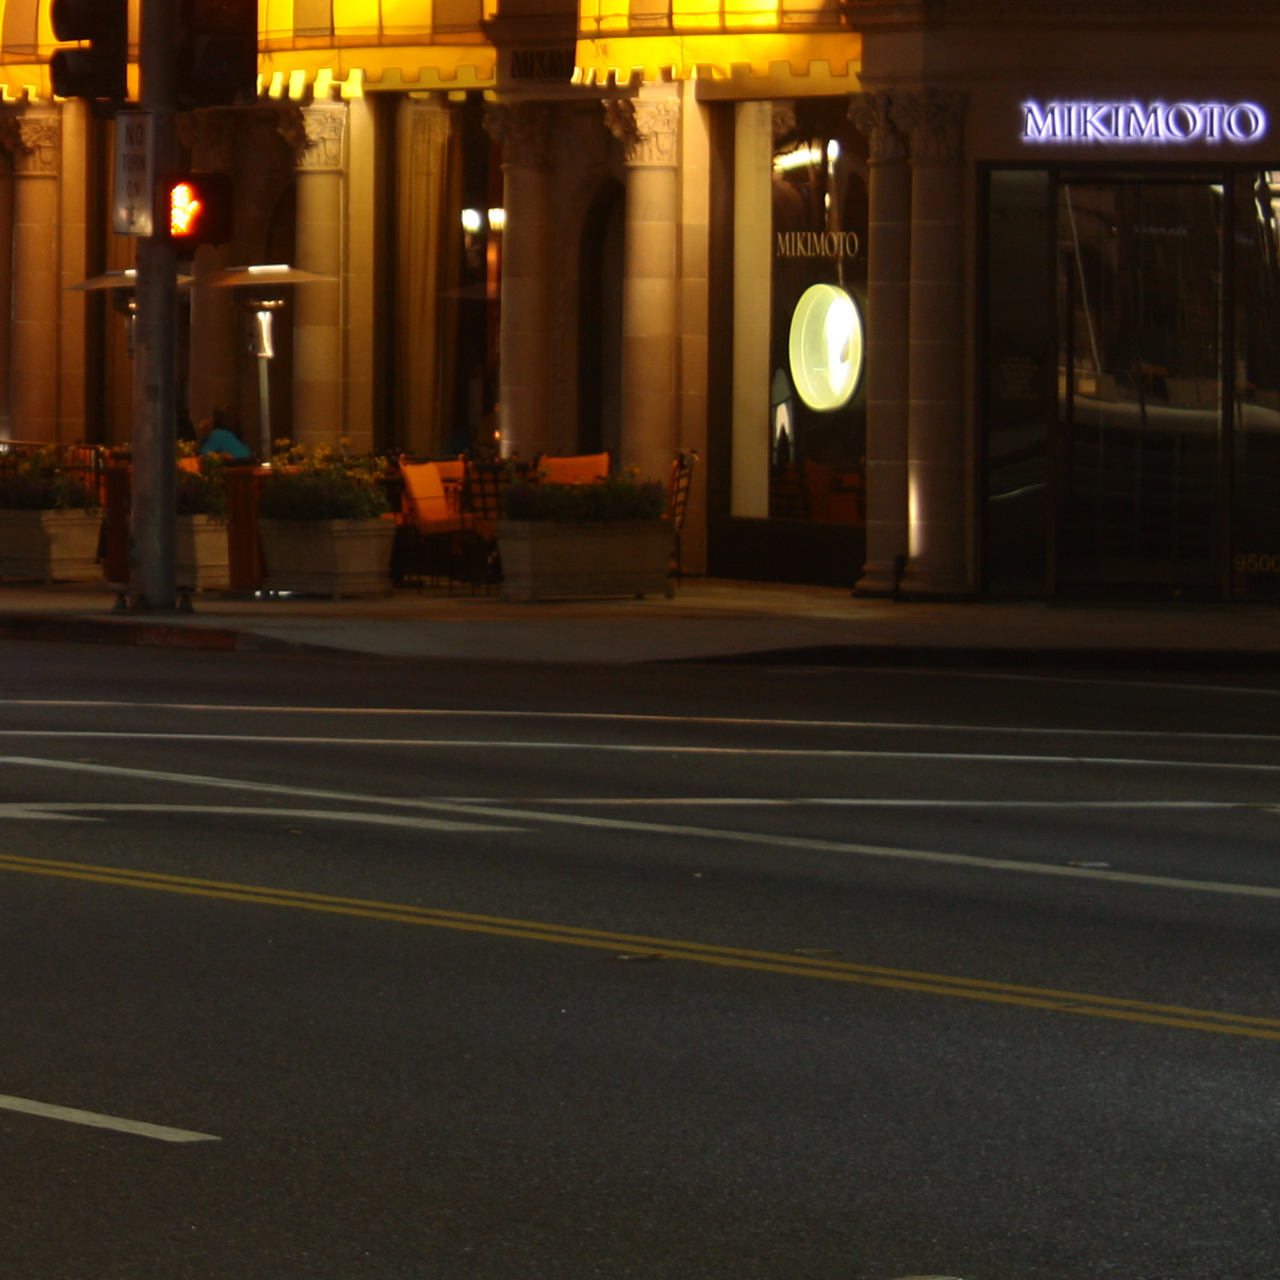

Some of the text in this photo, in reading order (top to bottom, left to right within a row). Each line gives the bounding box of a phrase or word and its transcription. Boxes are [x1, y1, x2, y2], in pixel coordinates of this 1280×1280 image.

[125, 123, 144, 145] NO
[1022, 102, 1267, 142] MIKIMOTO
[776, 231, 859, 257] MIKIMOTO
